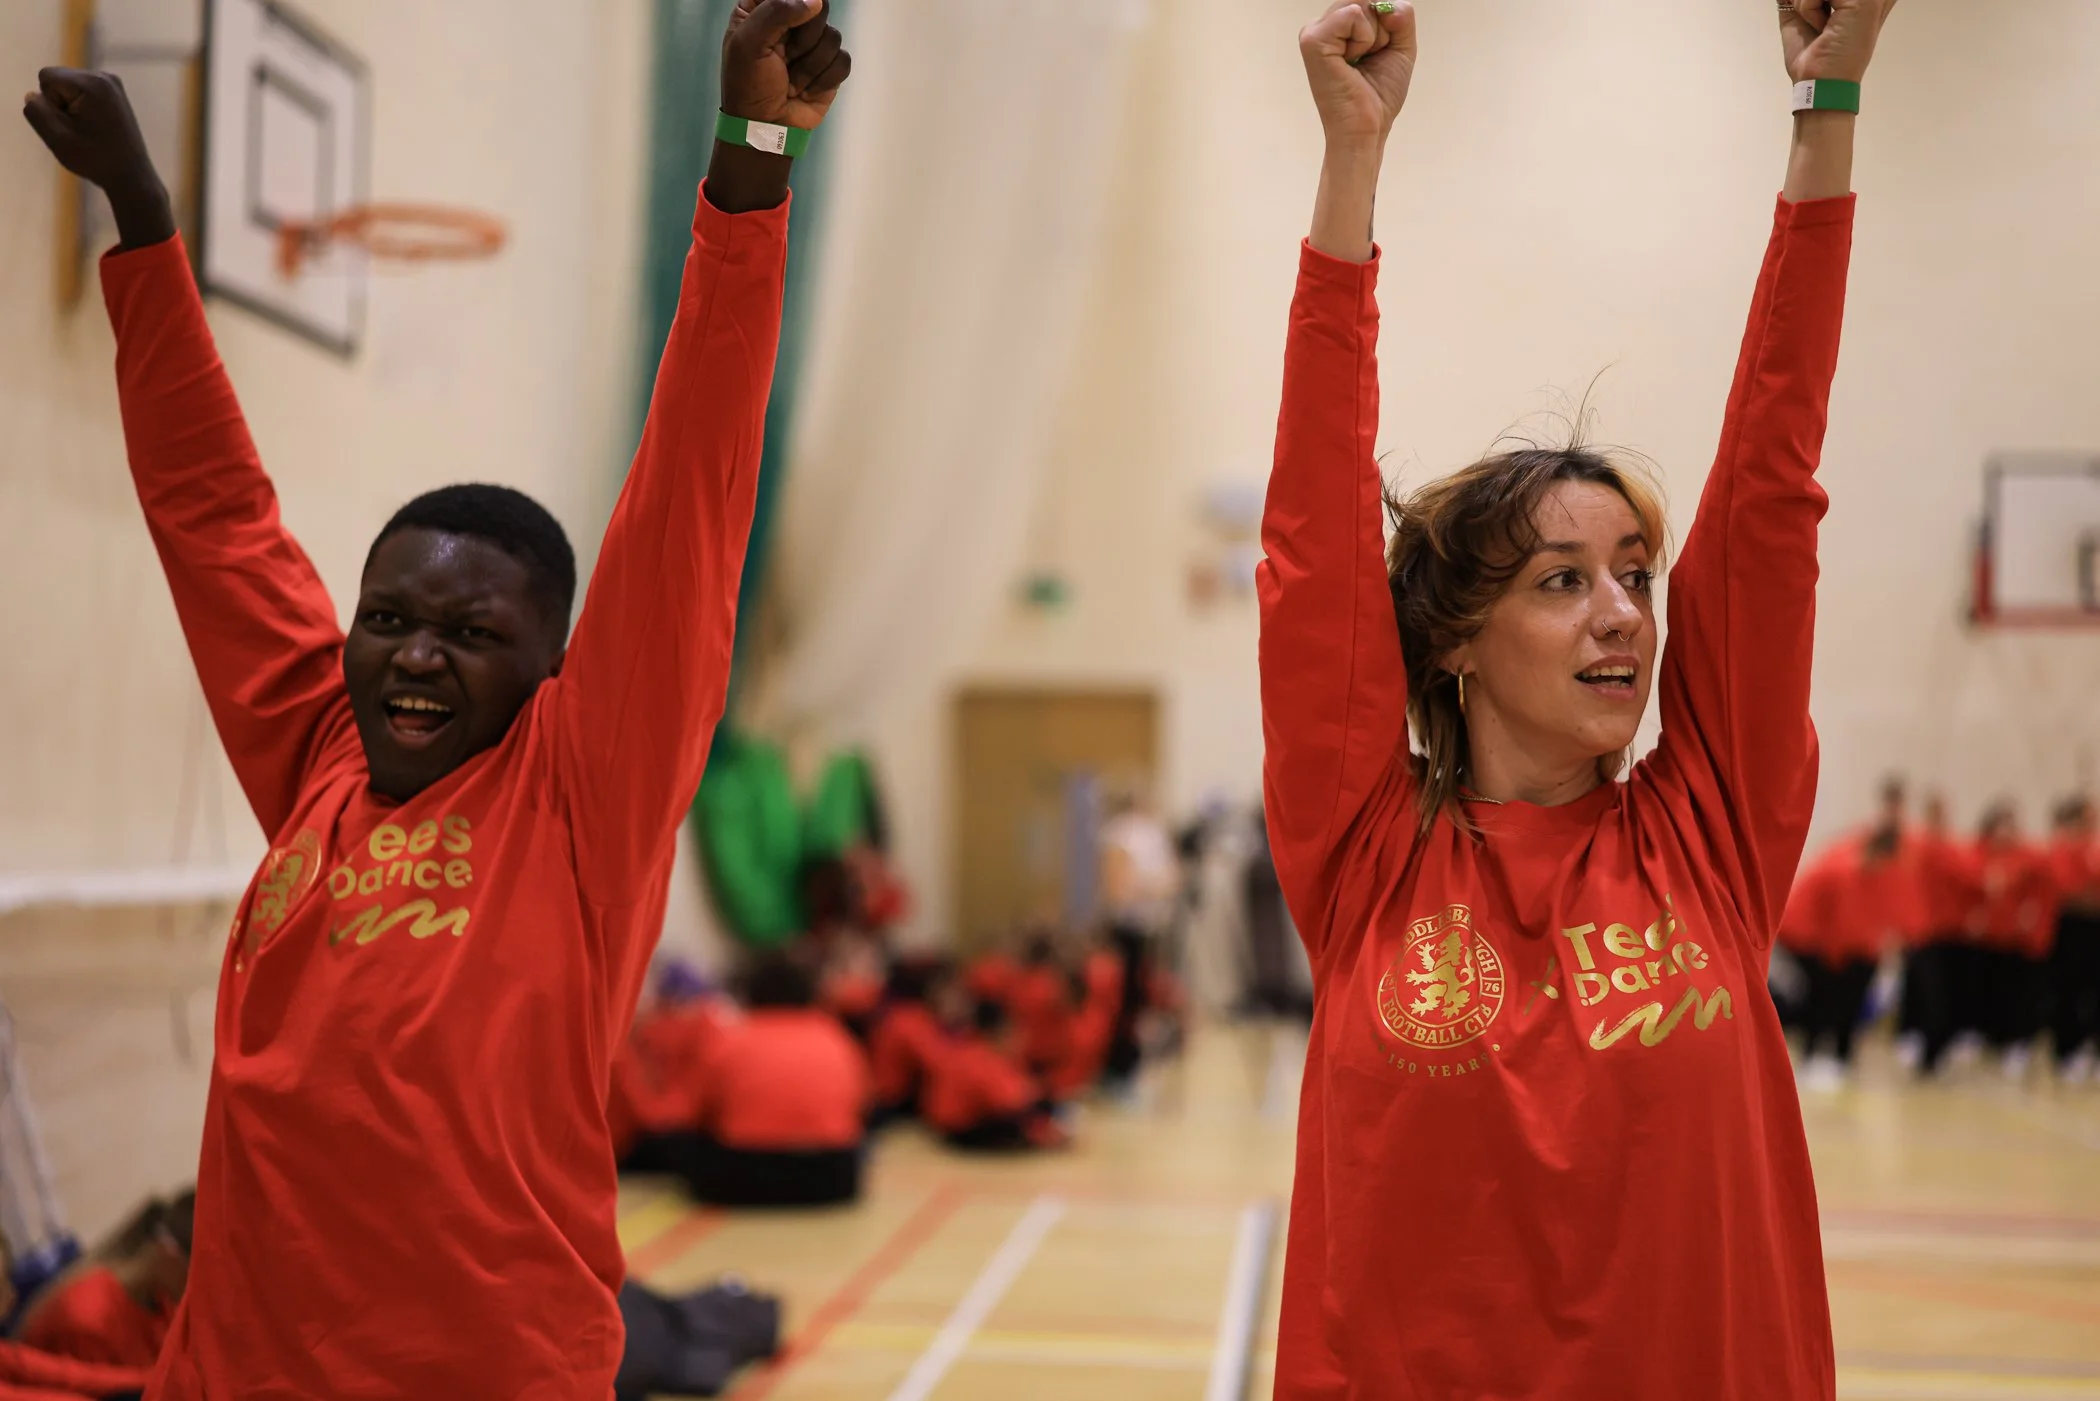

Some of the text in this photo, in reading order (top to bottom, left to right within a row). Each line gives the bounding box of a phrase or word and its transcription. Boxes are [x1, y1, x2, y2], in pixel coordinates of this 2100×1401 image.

[368, 814, 473, 862] ees
[1484, 982, 1500, 993] 76
[1382, 999, 1463, 1044] FOOTBALL
[1387, 1052, 1417, 1074] 150
